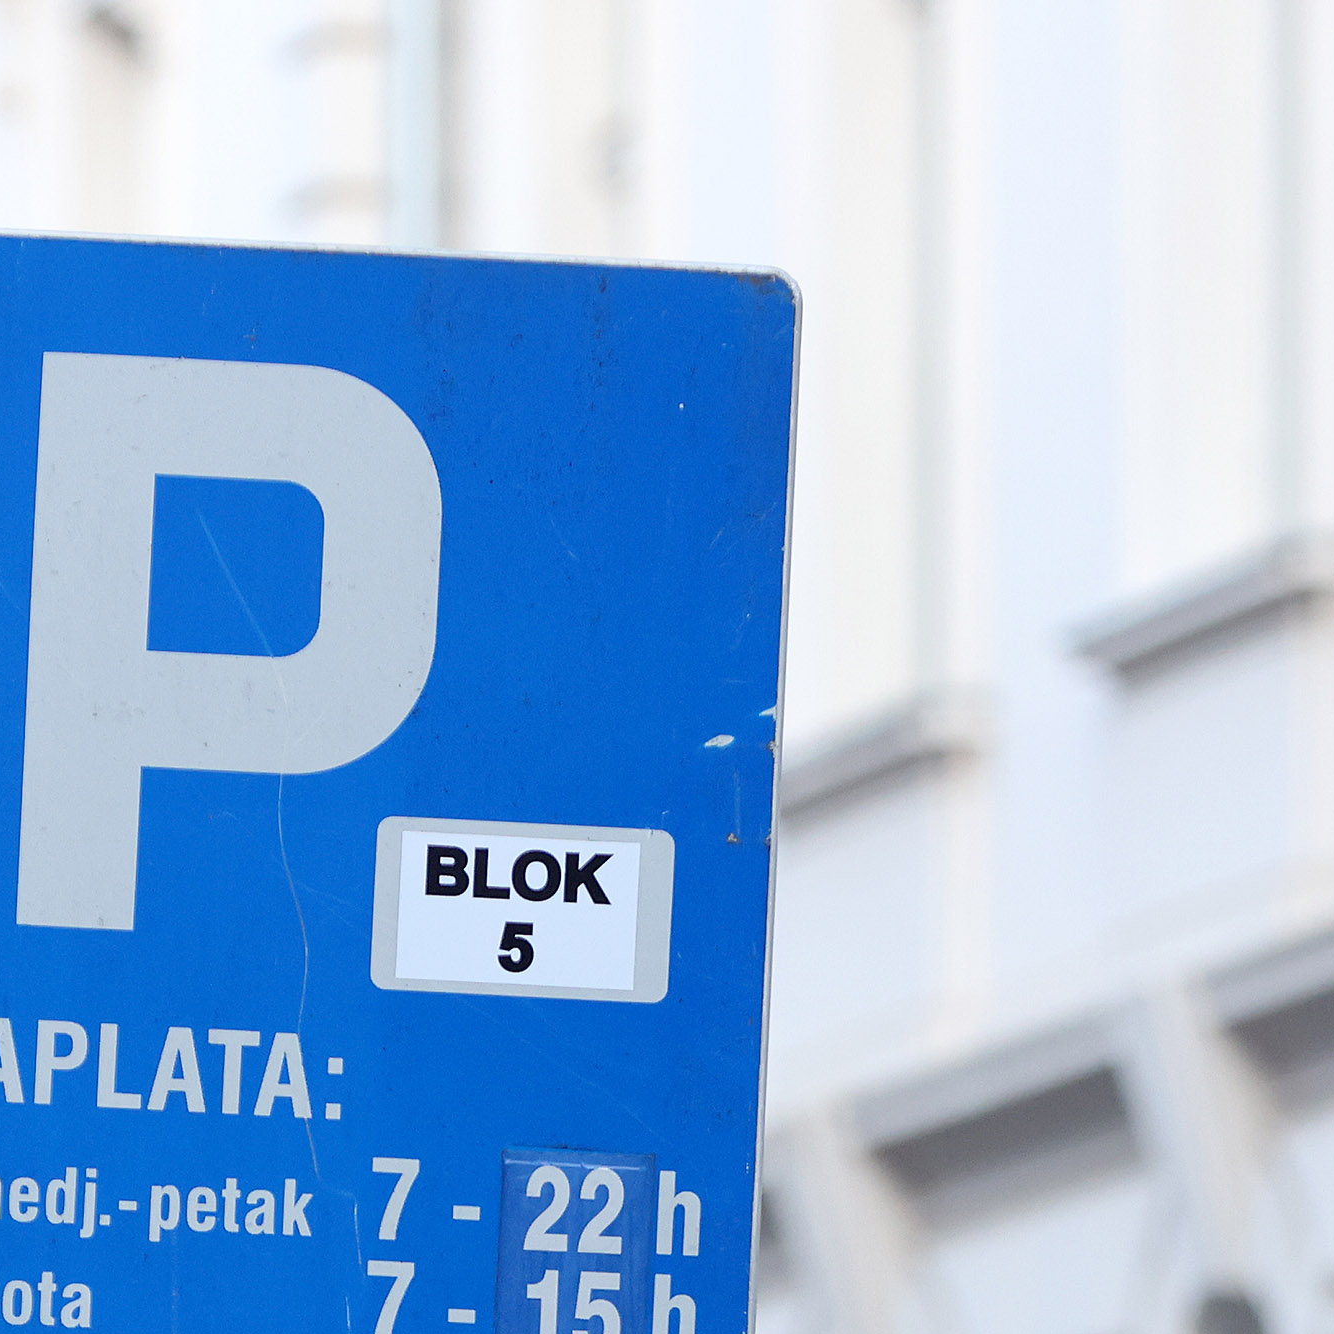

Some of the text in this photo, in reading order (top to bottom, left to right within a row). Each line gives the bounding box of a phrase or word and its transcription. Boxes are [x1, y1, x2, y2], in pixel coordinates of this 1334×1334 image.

[16, 351, 443, 931] P
[425, 845, 612, 905] BLOK
[498, 922, 534, 973] 5
[372, 1156, 420, 1241] 7
[523, 1161, 625, 1255] 22
[656, 1170, 702, 1257] h
